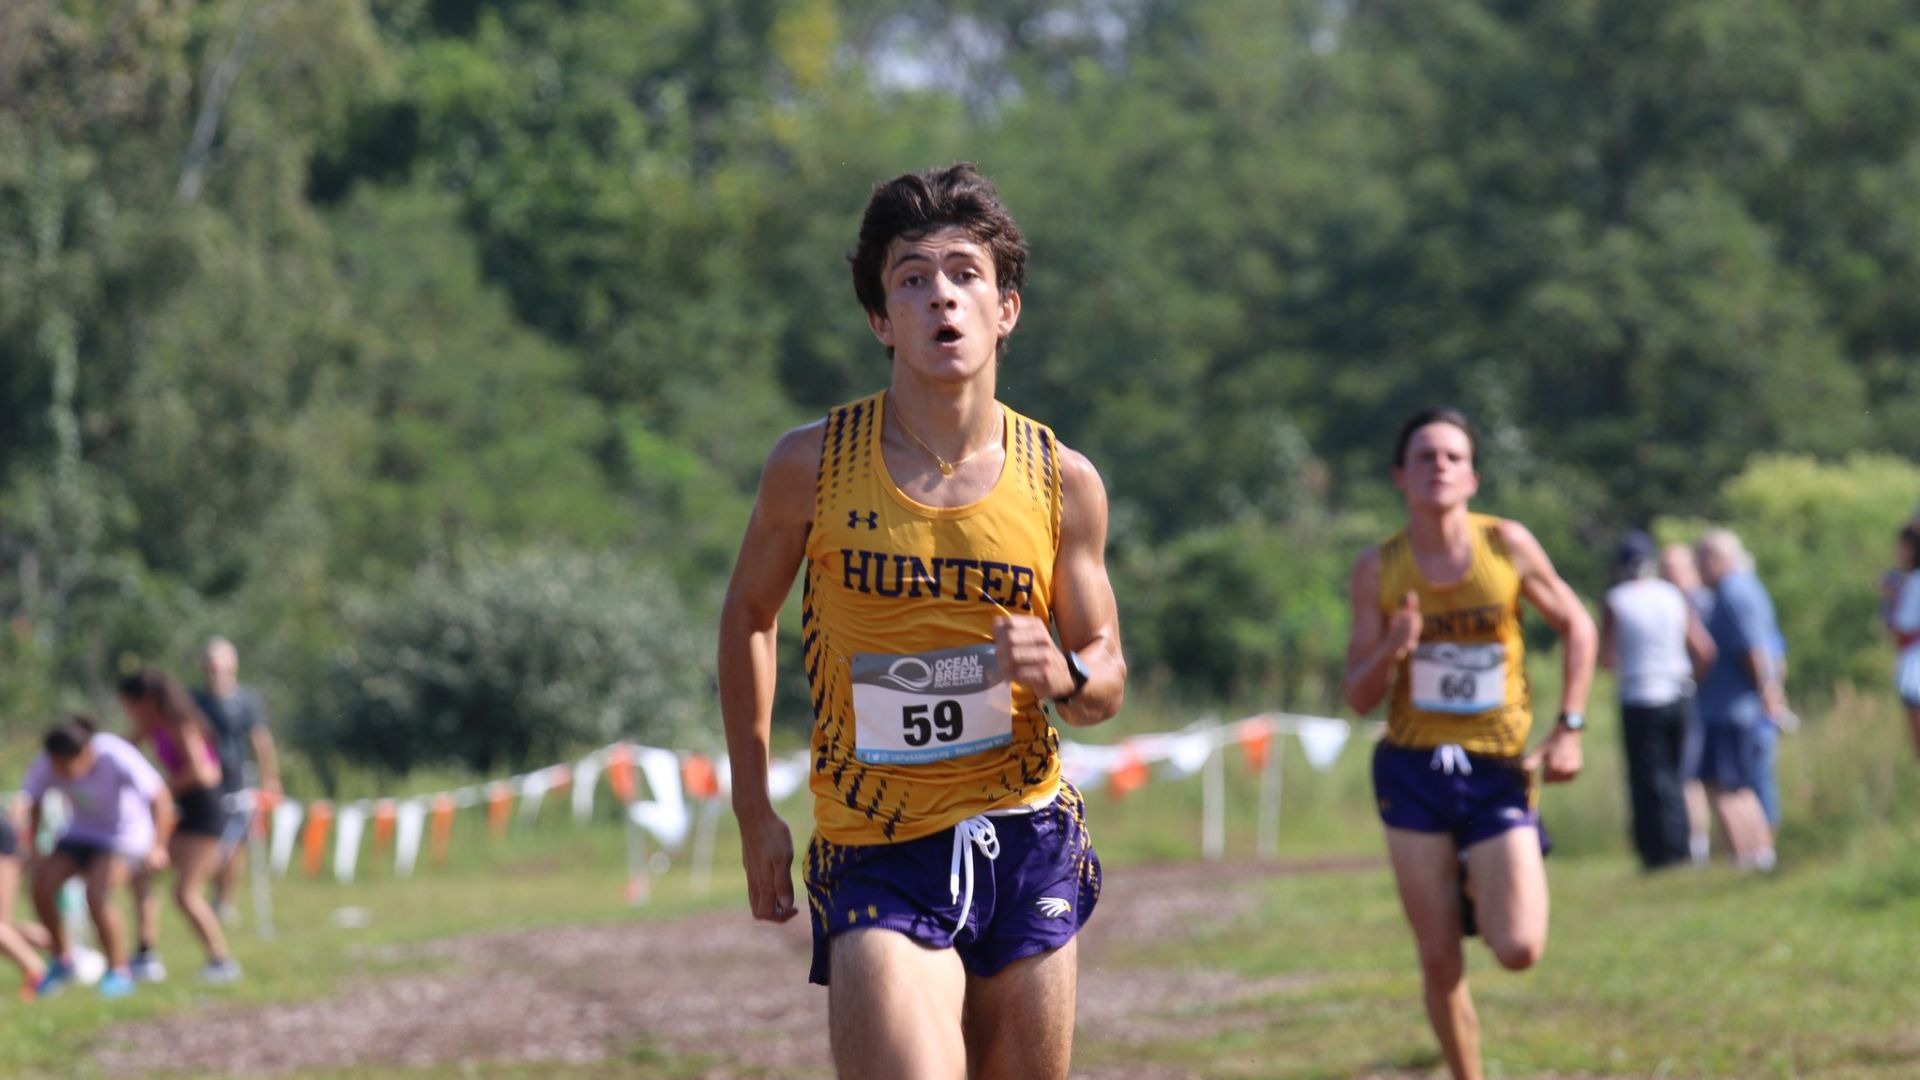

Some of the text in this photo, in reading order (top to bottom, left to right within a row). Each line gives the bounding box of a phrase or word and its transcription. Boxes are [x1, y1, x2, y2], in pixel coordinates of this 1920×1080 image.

[840, 548, 1034, 611] HUNTER
[935, 654, 978, 671] OCEAN
[935, 665, 984, 682] BREEZE
[1440, 673, 1476, 700] 60
[902, 699, 963, 747] 59
